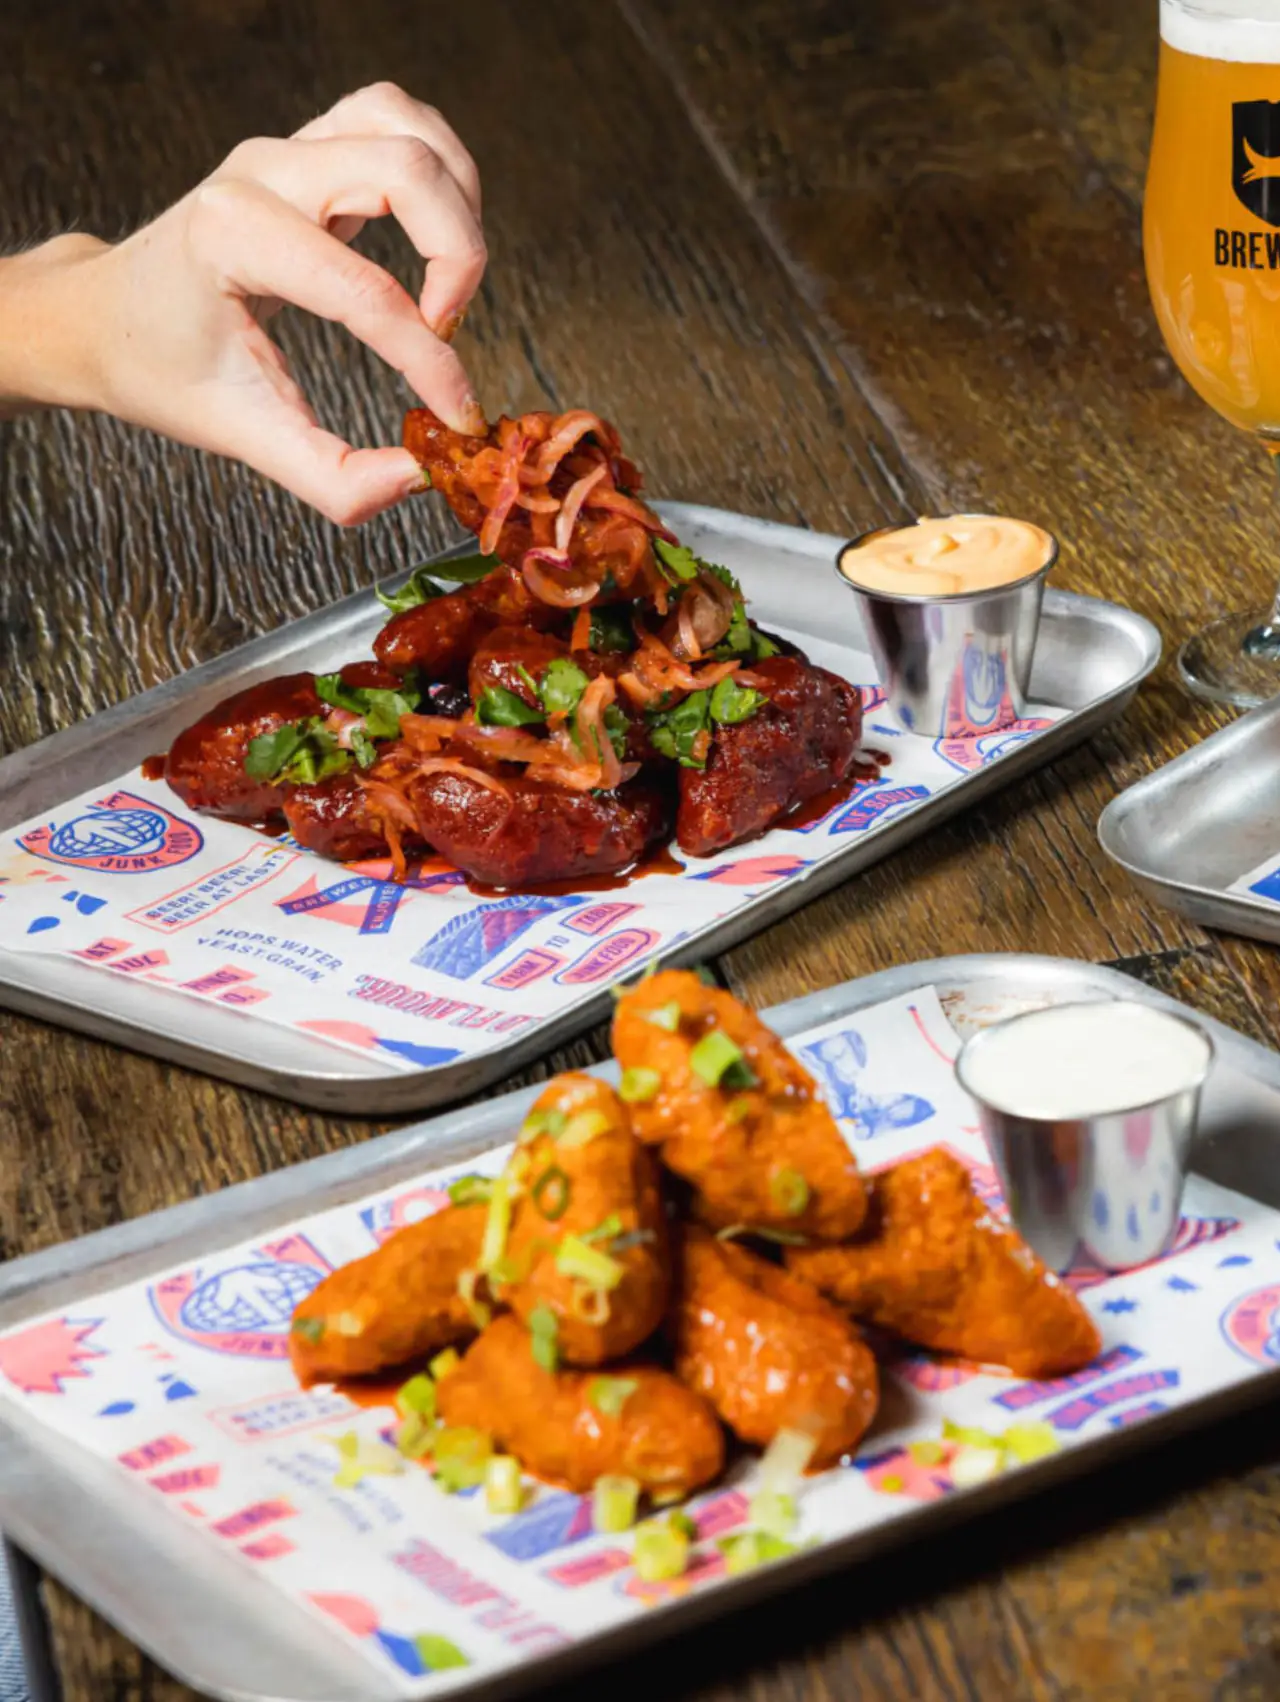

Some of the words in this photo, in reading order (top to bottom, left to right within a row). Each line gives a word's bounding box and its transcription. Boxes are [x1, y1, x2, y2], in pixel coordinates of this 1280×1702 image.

[99, 856, 166, 870] JUNK
[160, 900, 212, 925] BEER
[210, 886, 233, 902] AT
[544, 934, 570, 949] TO
